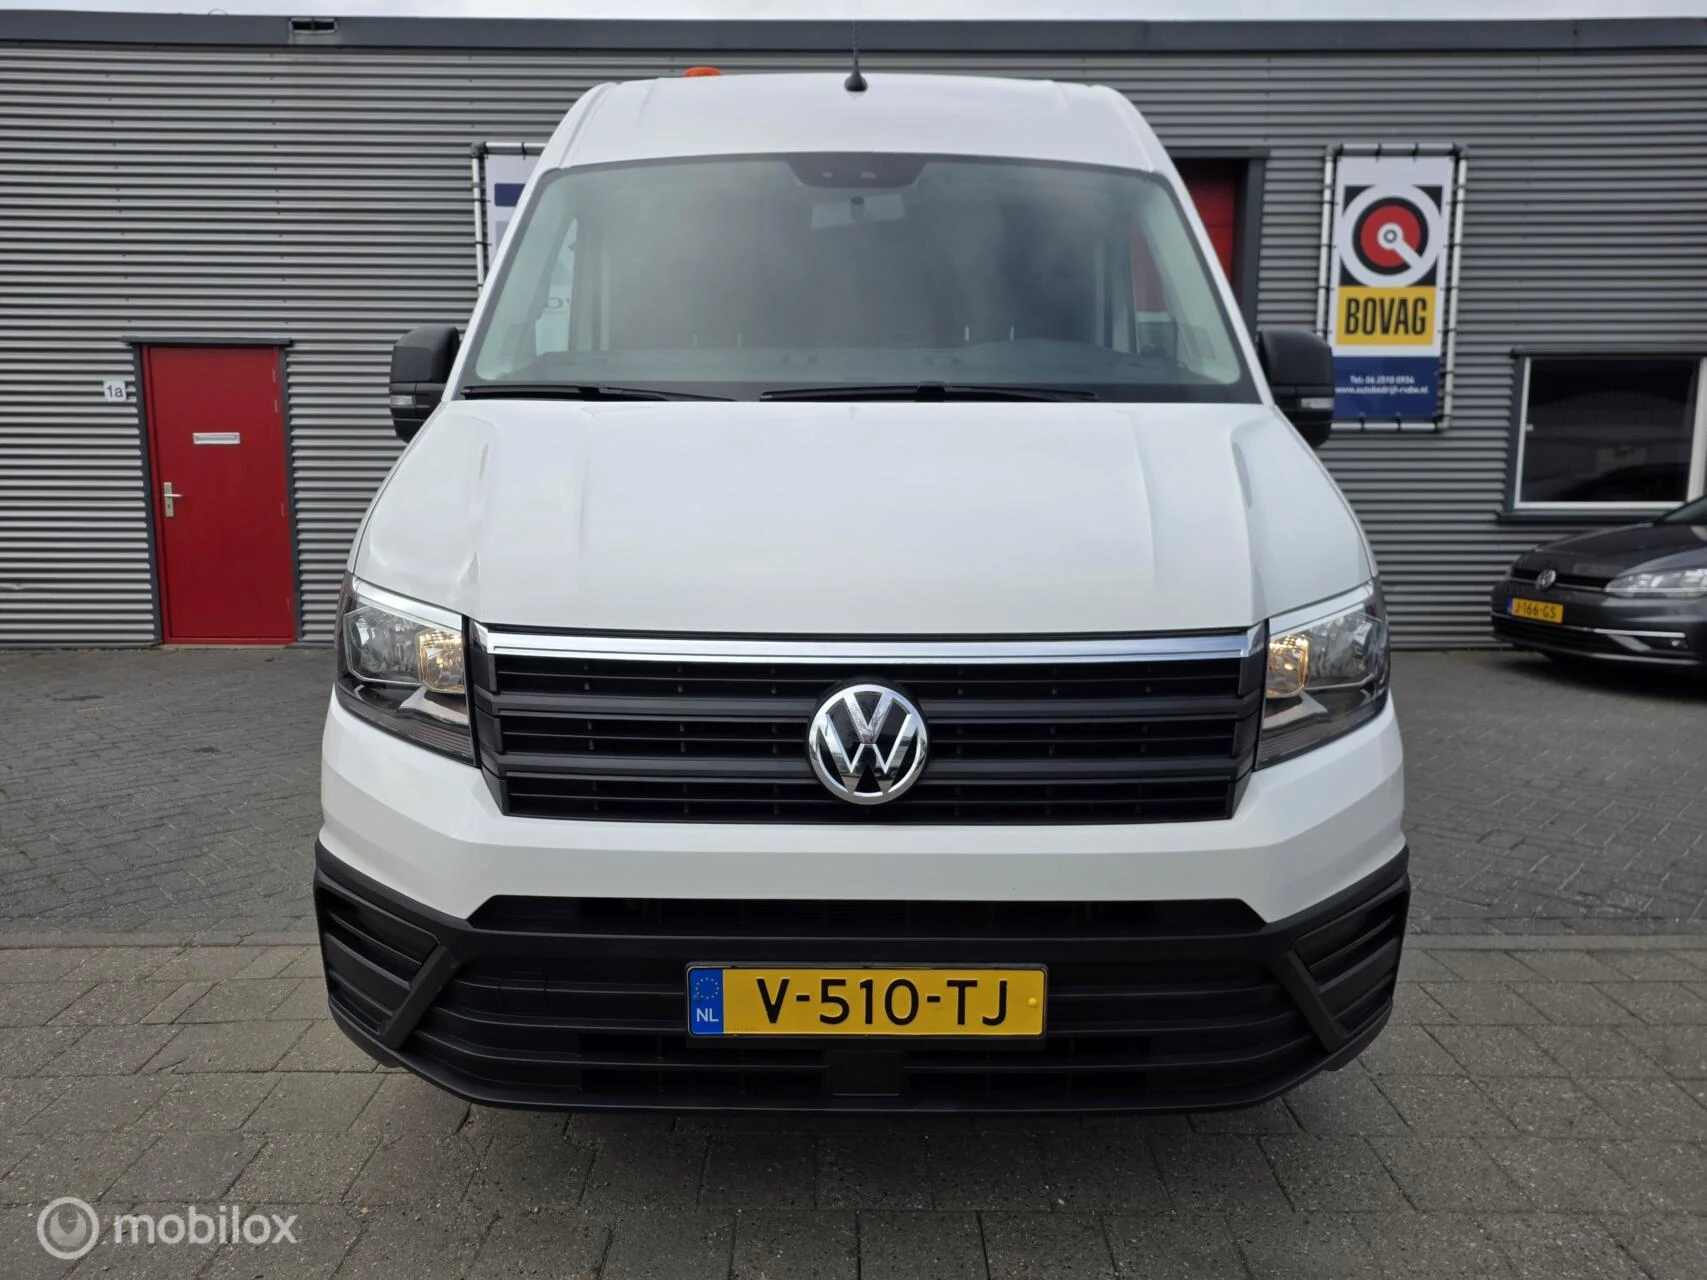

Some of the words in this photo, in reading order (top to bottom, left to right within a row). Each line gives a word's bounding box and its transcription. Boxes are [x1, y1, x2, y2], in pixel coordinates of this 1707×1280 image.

[1345, 297, 1427, 335] BOVAG
[107, 384, 123, 398] 1a
[696, 1008, 719, 1022] NL
[756, 978, 1008, 1026] V-510-TJ
